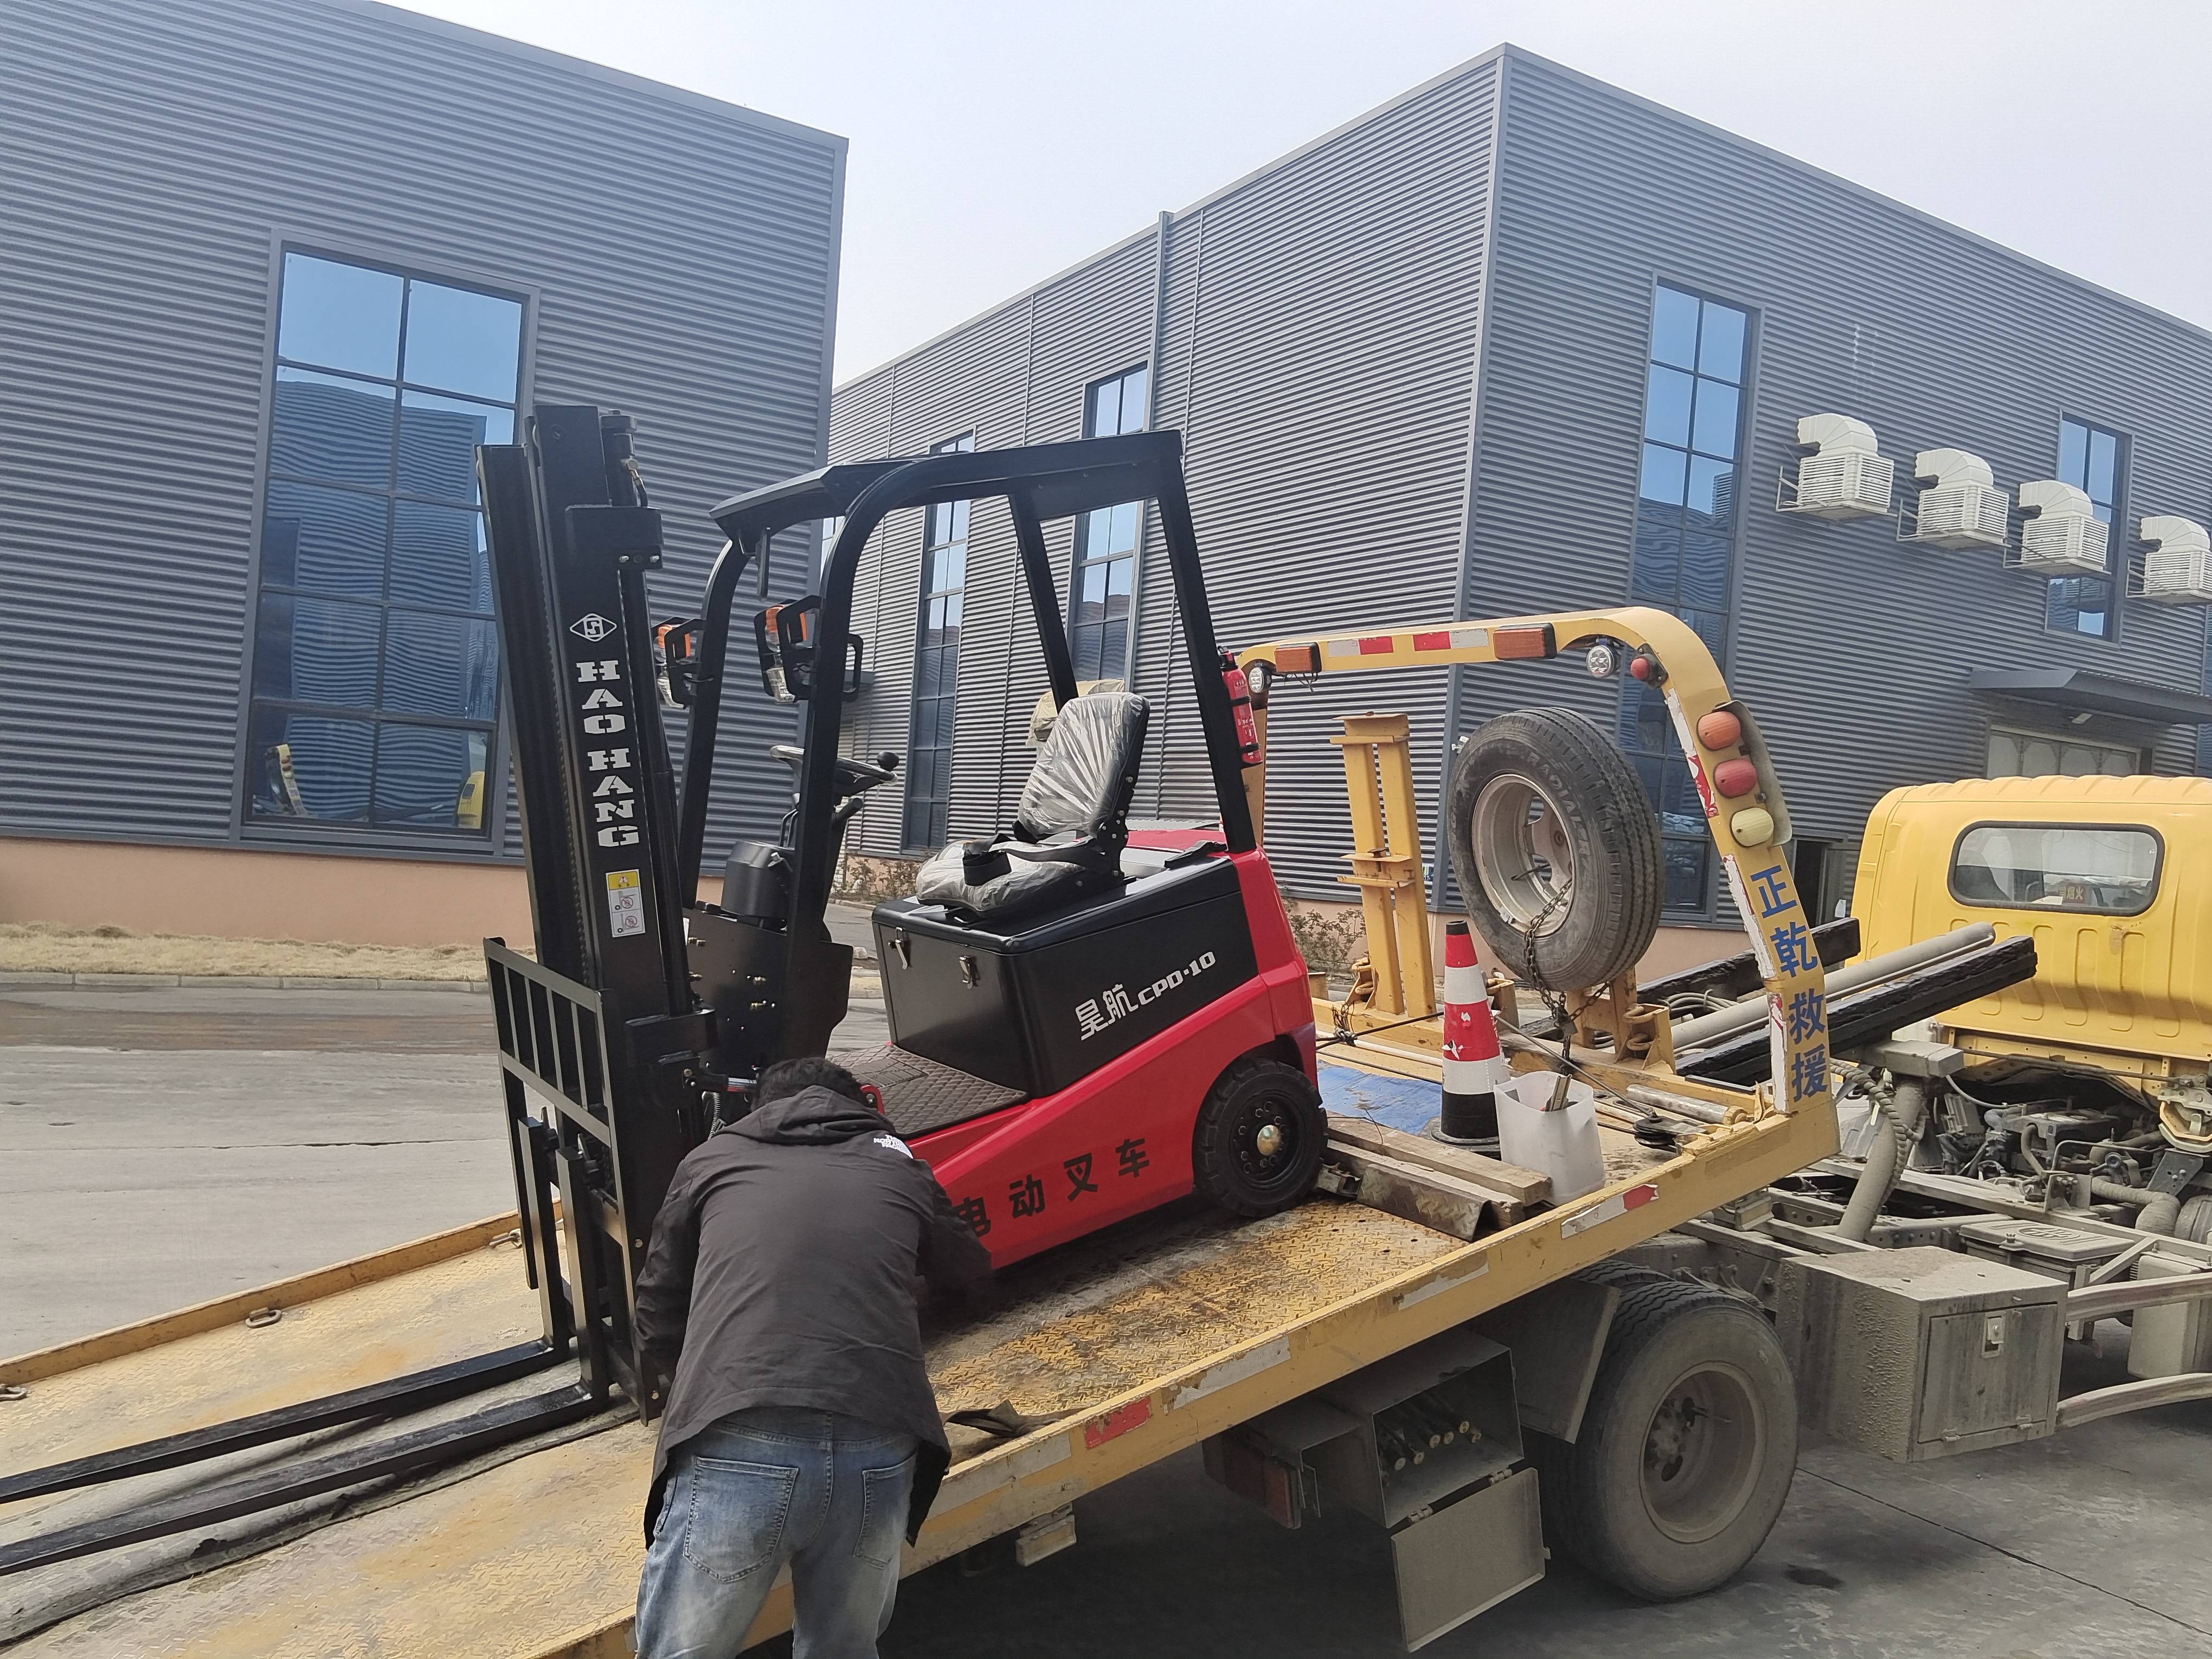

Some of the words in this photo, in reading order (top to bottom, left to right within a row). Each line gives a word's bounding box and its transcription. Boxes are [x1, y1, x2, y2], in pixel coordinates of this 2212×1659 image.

[576, 660, 626, 734] HAO
[588, 748, 639, 847] HANG
[1750, 865, 1828, 1102] 正乾救援
